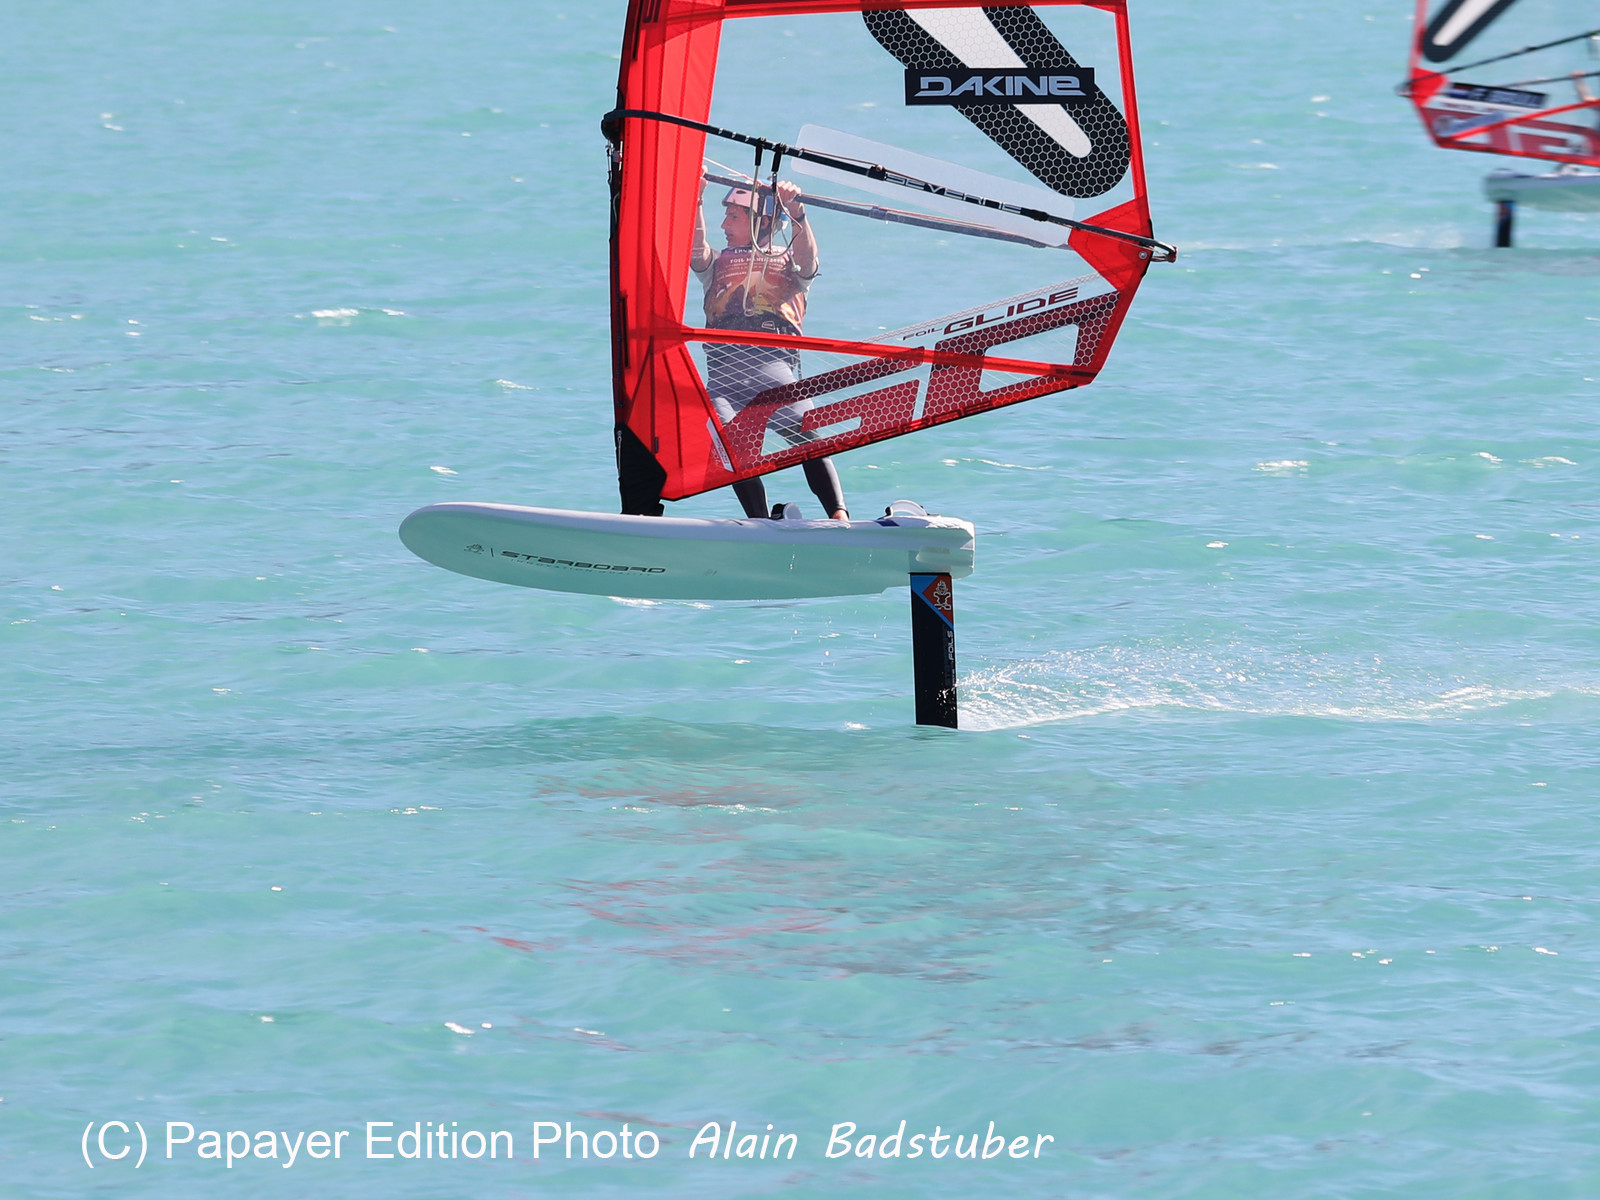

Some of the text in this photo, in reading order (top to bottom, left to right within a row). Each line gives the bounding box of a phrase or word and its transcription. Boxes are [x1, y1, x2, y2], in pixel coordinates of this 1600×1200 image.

[913, 75, 1088, 97] DAKINE
[902, 286, 1080, 341] FOIL GLIDE
[500, 550, 667, 574] STARBOARD
